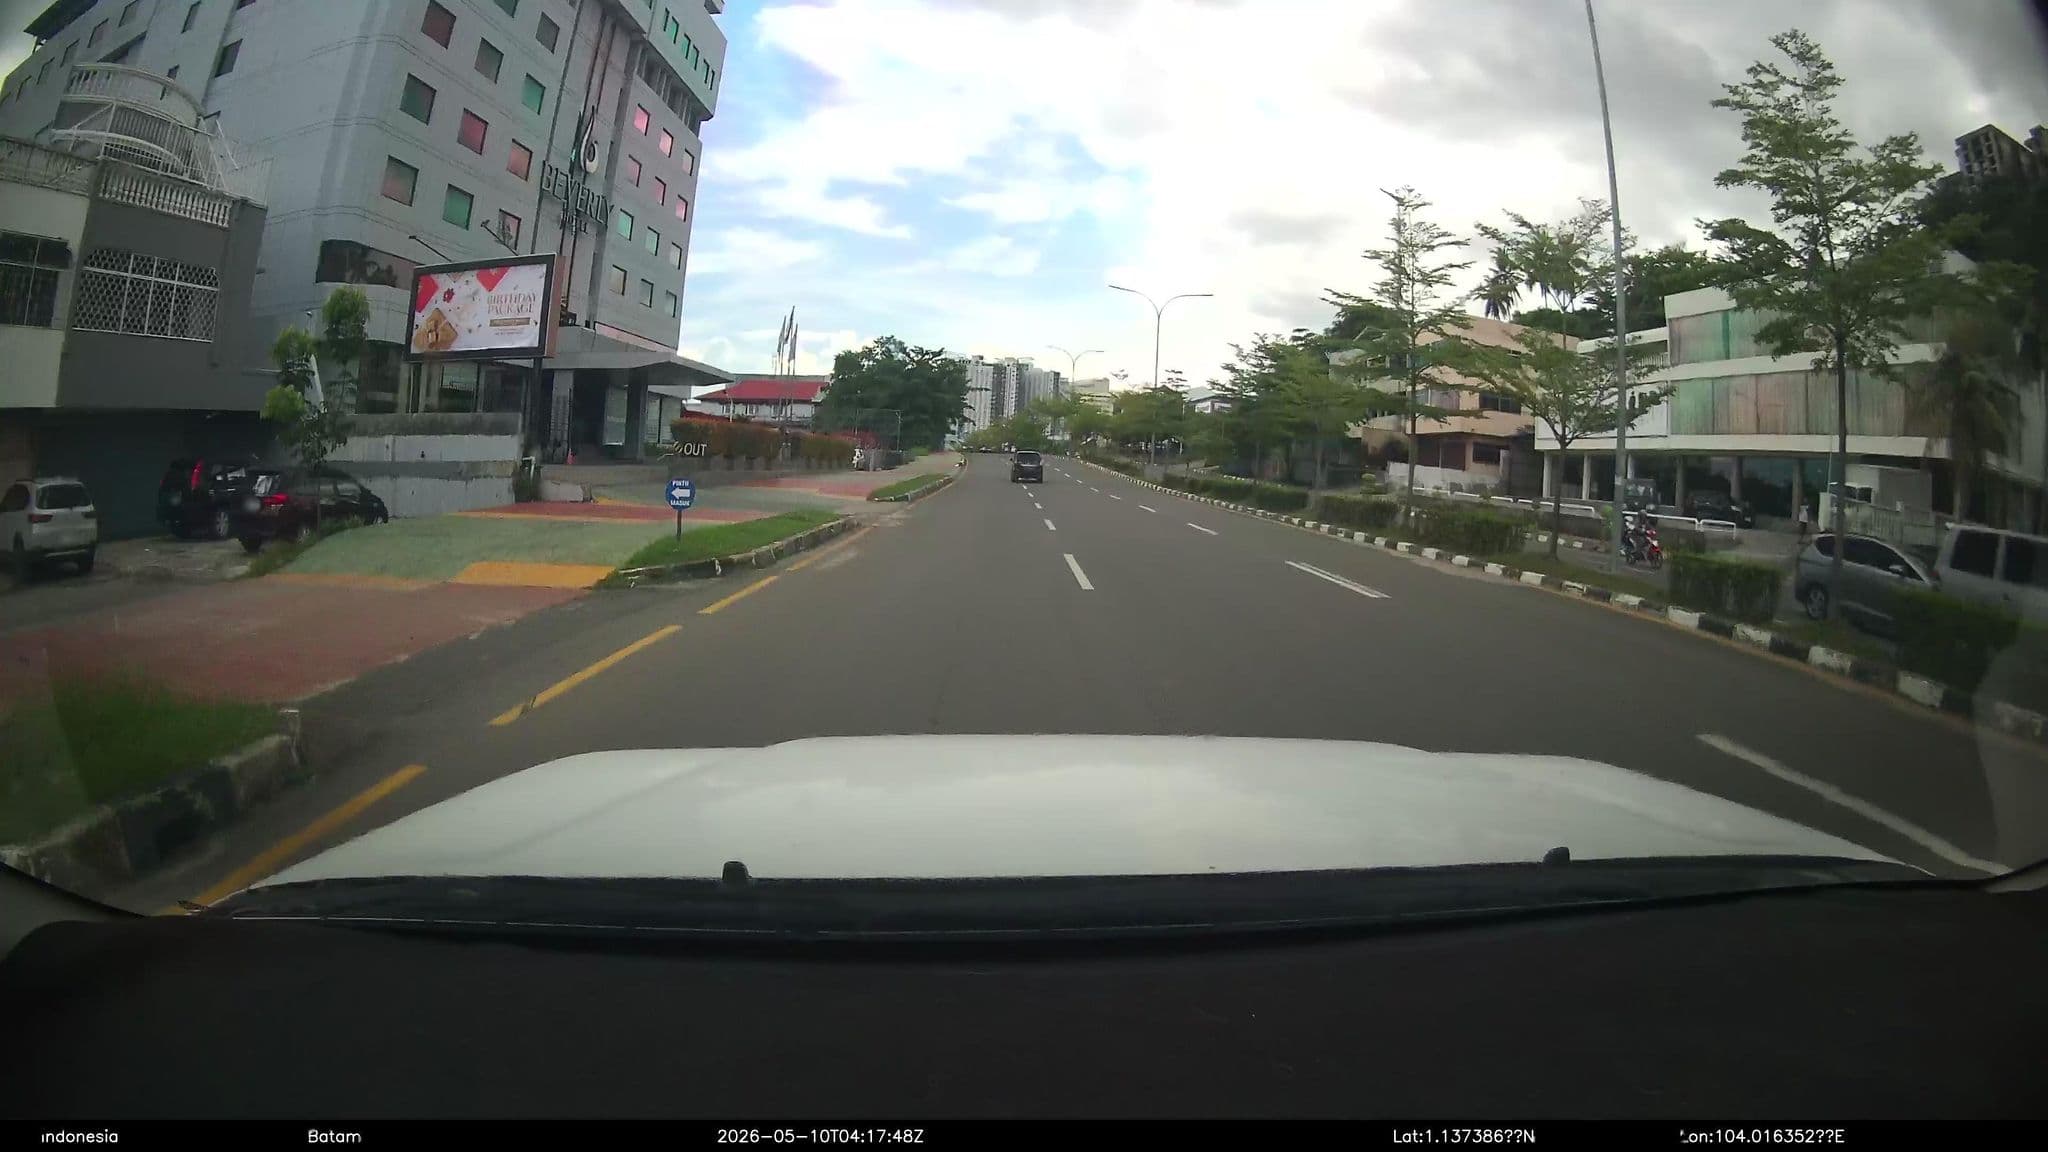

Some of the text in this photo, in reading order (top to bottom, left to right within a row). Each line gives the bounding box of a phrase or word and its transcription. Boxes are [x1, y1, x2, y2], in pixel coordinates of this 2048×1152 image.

[542, 160, 615, 228] BEVERLY
[487, 293, 536, 304] BIRTHDAY
[488, 304, 533, 315] PACKAGE
[684, 442, 707, 456] OUT
